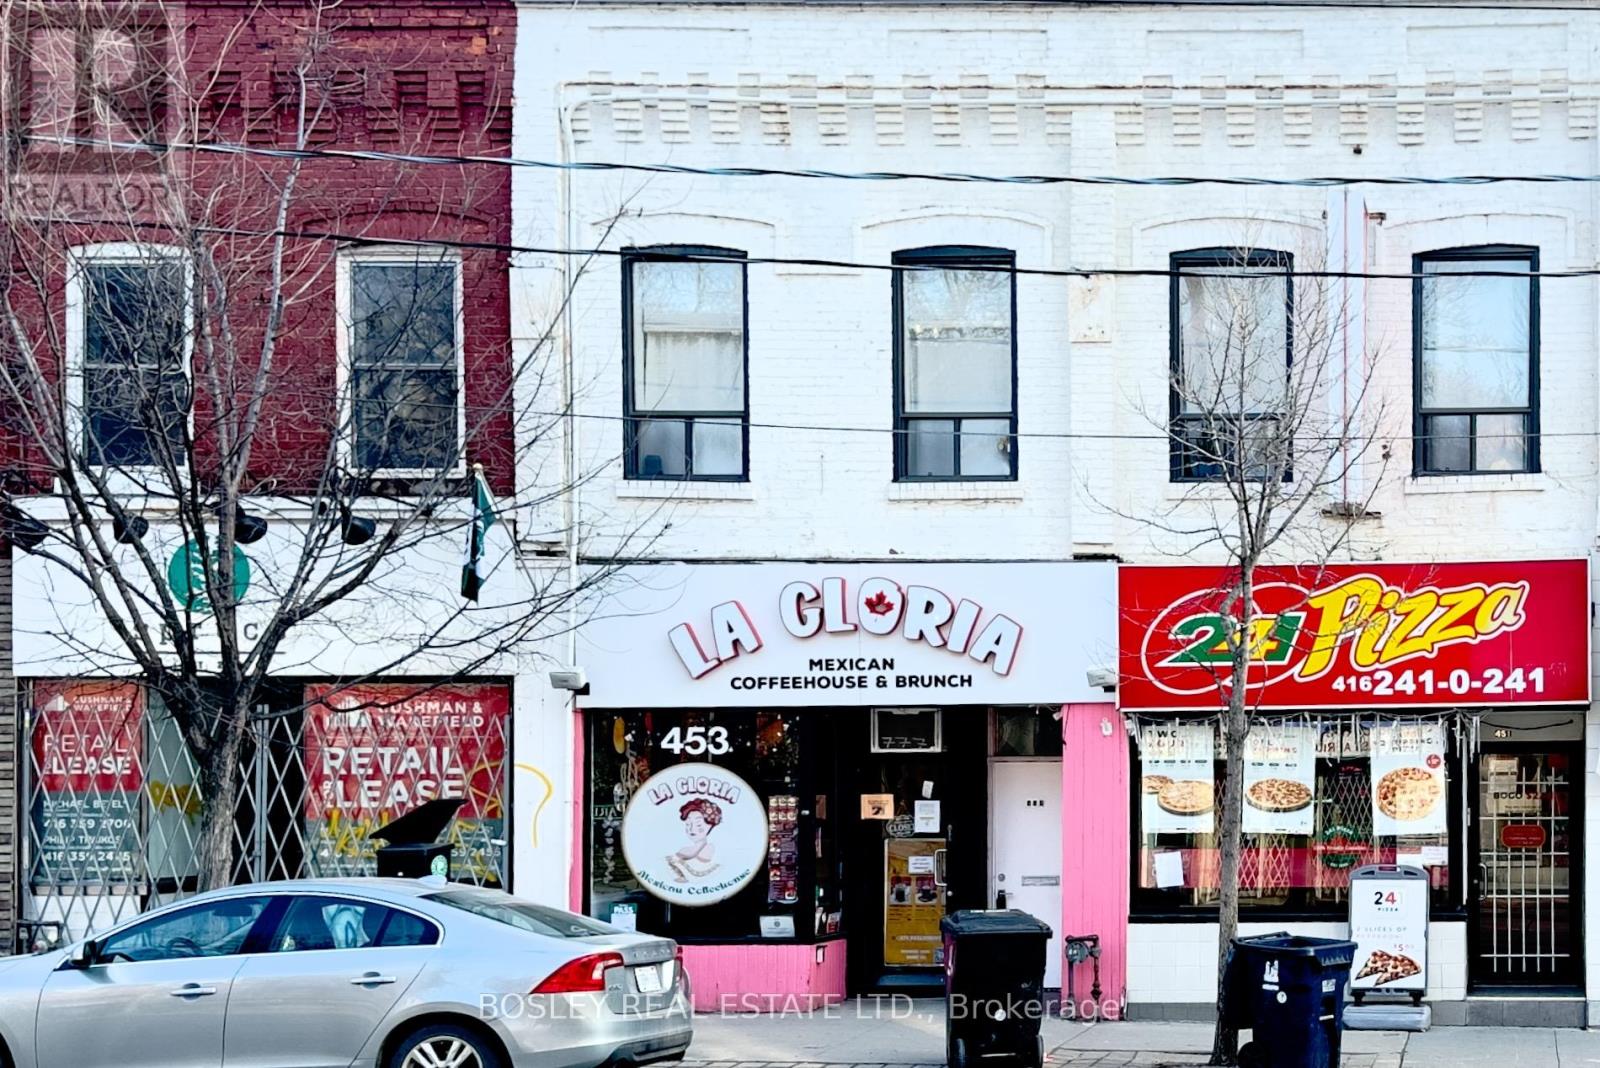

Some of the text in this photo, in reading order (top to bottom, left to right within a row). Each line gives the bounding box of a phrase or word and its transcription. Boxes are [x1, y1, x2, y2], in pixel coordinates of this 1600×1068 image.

[667, 576, 1024, 680] LA GLORIA
[1296, 573, 1531, 682] Pizza
[808, 657, 896, 672] MEXICAN
[730, 674, 973, 691] COFFEEHOUSE & BRUNCH
[1373, 667, 1545, 695] 241-0-241
[73, 704, 132, 712] WAEFIED
[378, 701, 484, 714] CUSHMAN &
[44, 734, 128, 753] RETAIL
[660, 726, 729, 755] 453
[53, 756, 132, 775] LEASE
[323, 746, 466, 775] RETAIL
[335, 779, 464, 808] LEASE
[647, 776, 741, 806] LA GLORIA
